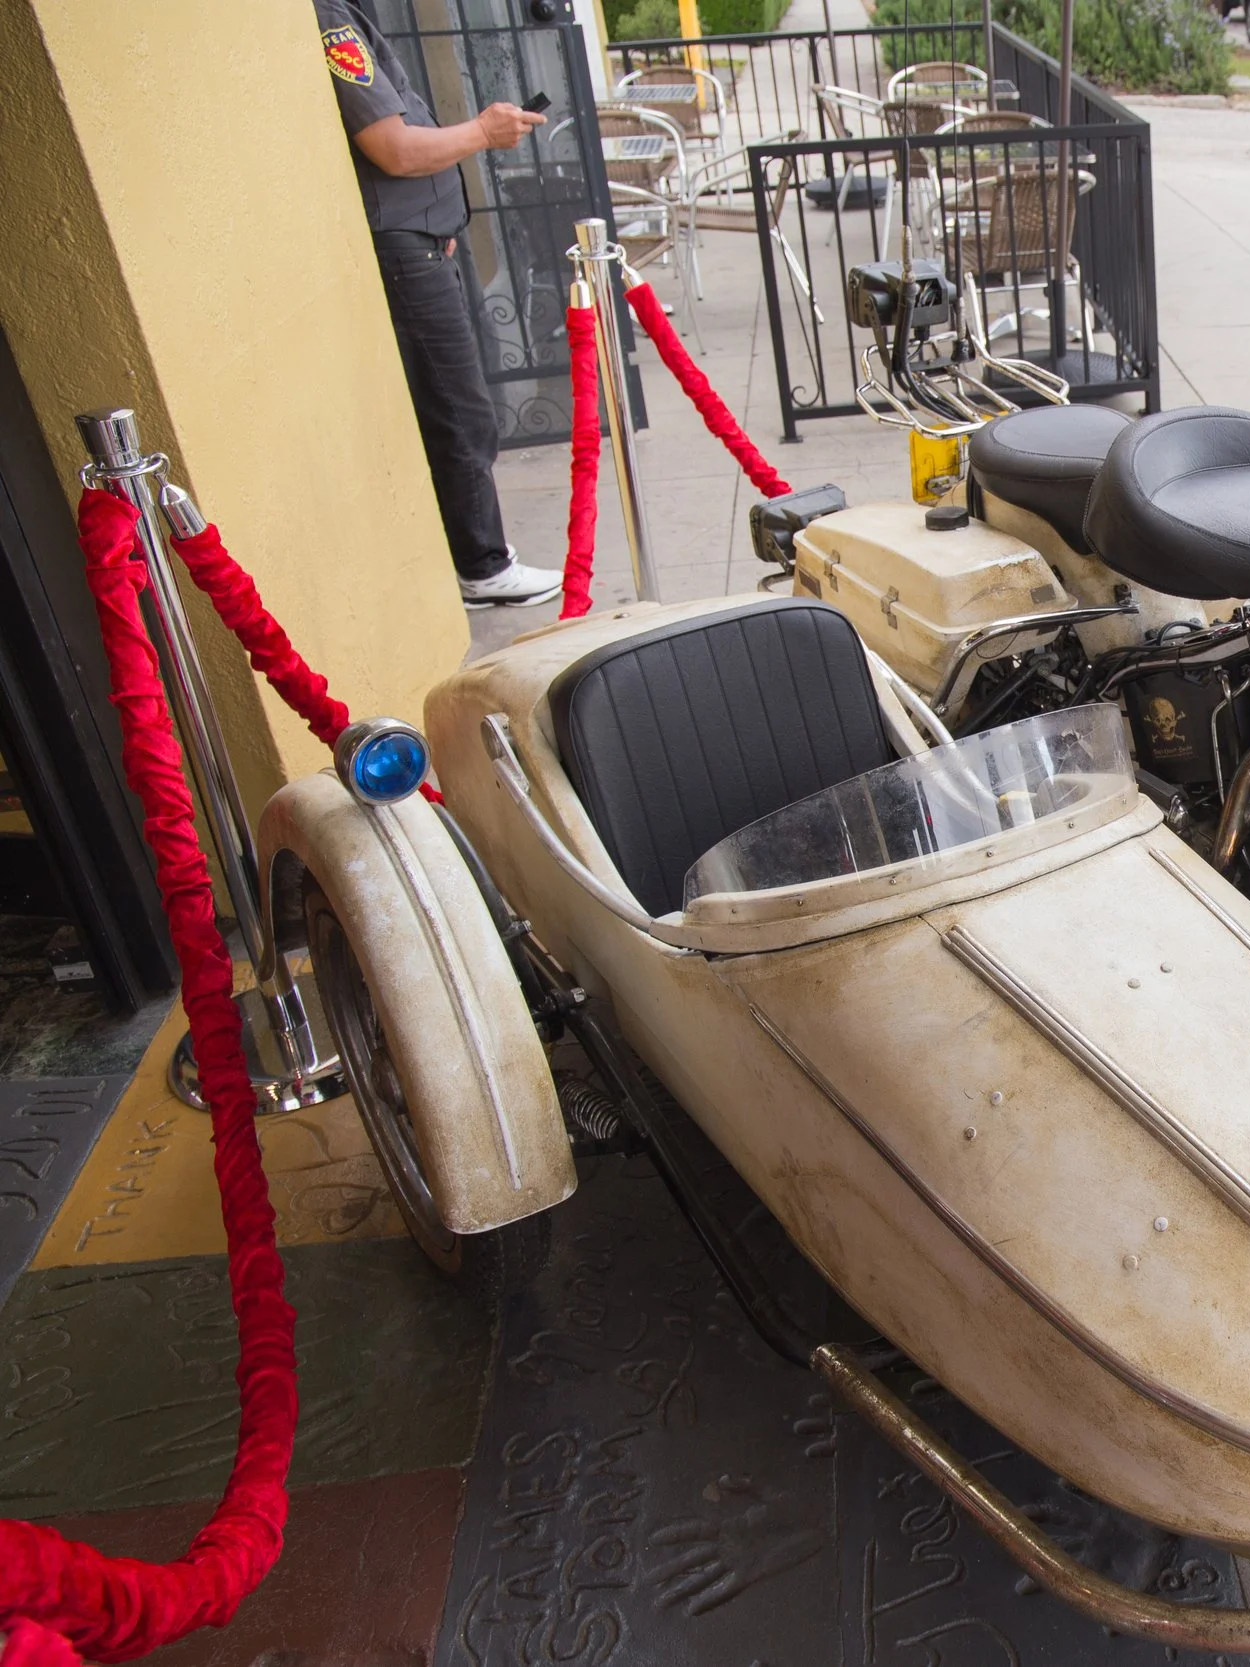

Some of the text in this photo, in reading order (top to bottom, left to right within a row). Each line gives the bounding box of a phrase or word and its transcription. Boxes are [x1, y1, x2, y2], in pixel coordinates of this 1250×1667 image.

[330, 48, 364, 69] SSC
[74, 1116, 179, 1252] THANK
[454, 1430, 578, 1667] JAMES
[539, 1426, 647, 1666] STORM
